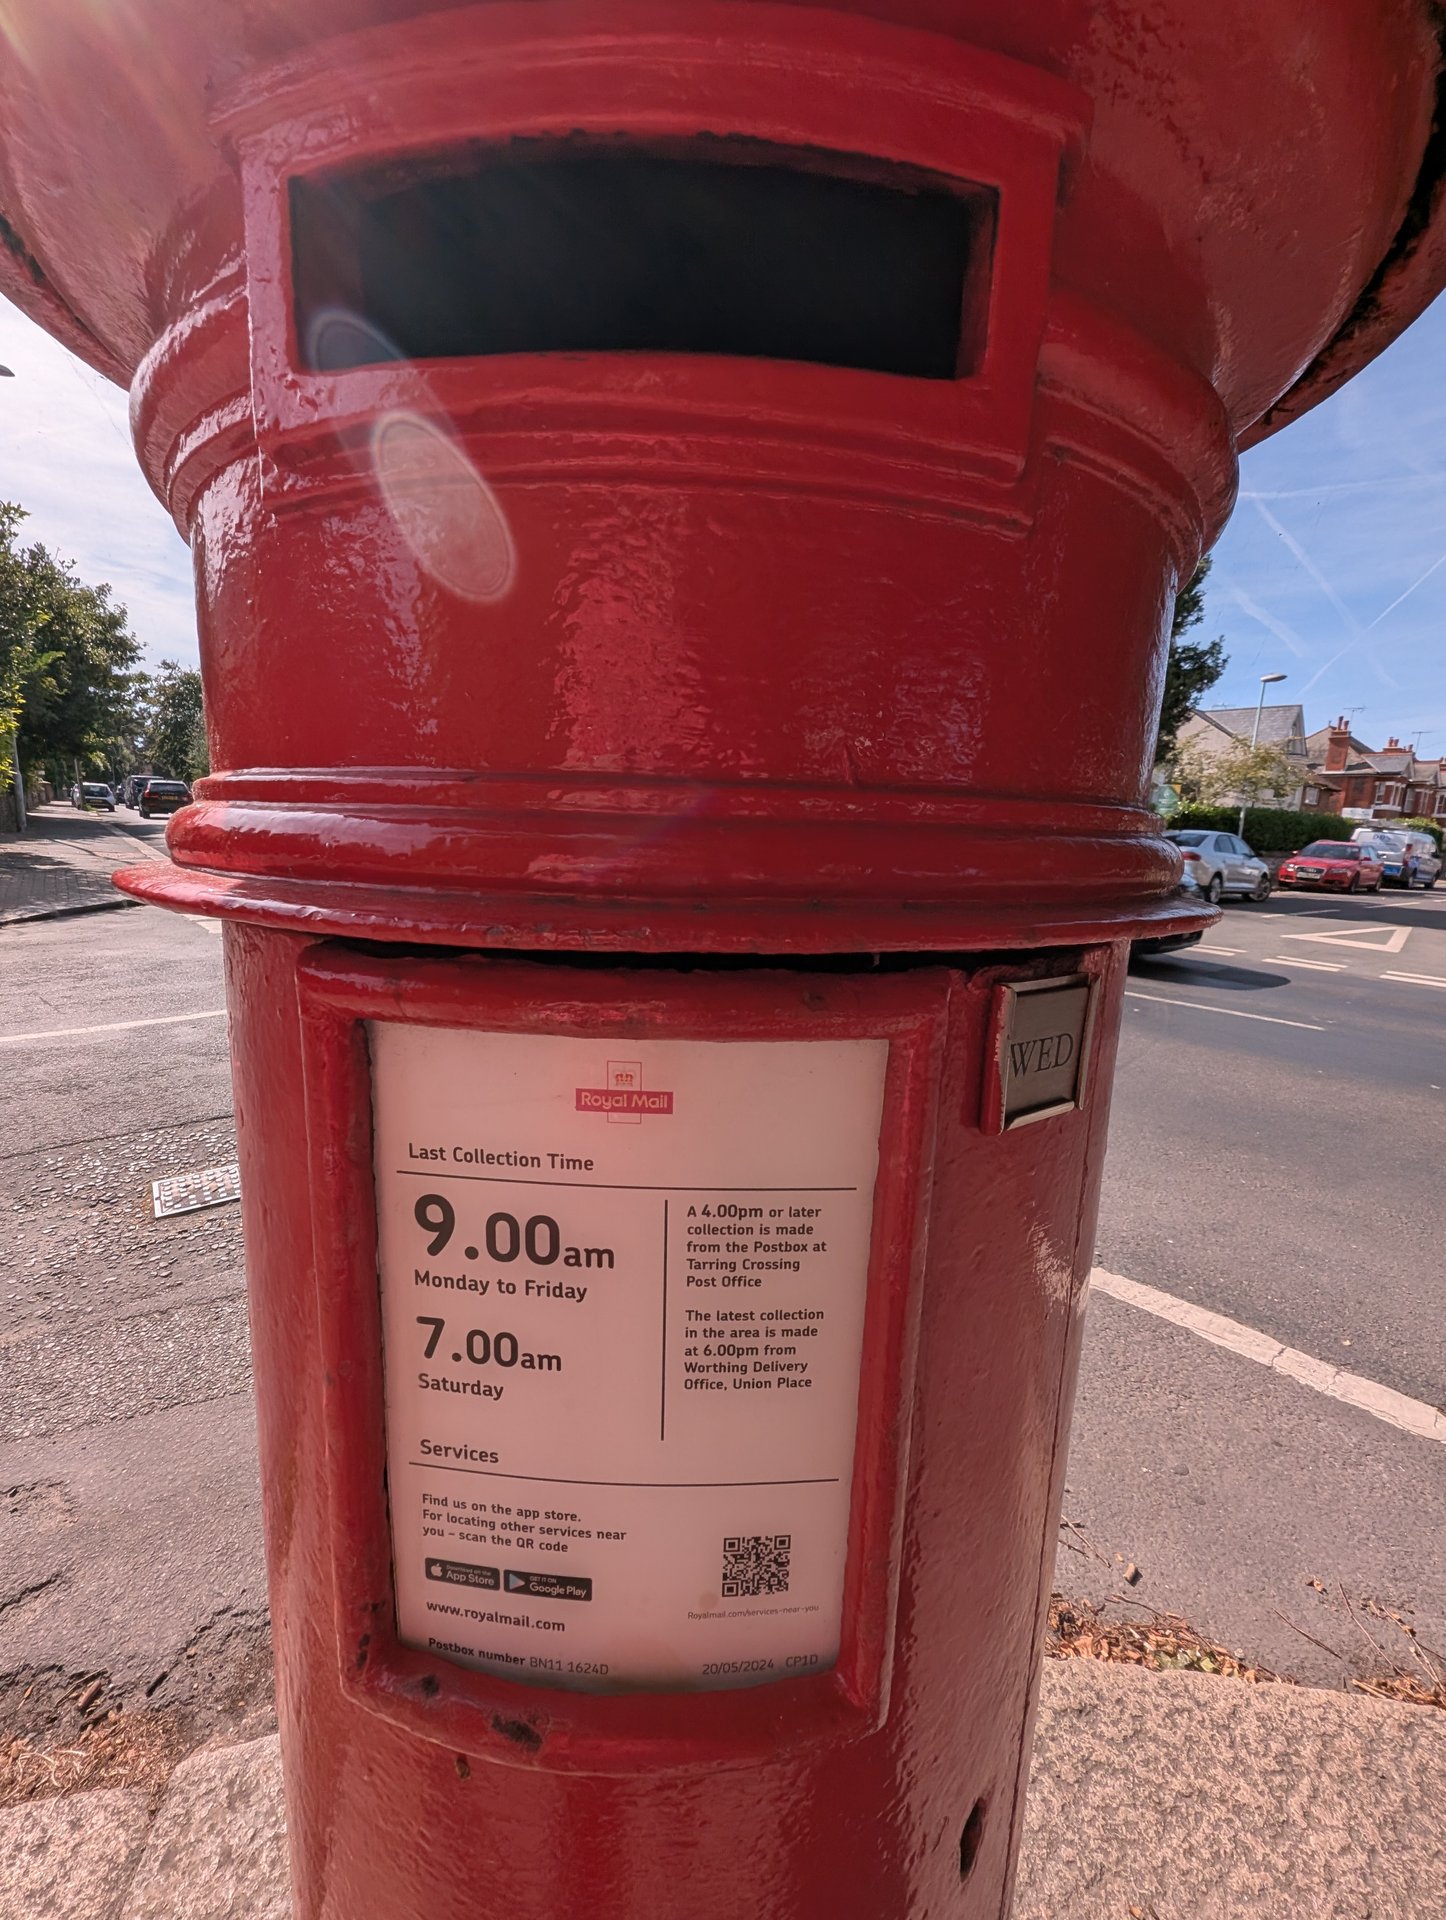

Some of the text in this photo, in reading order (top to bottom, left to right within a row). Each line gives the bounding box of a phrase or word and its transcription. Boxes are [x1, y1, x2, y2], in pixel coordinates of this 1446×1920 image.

[1009, 1033, 1074, 1078] WED
[580, 1092, 668, 1112] Royal Mail
[409, 1143, 594, 1171] Last Collection Time
[687, 1204, 821, 1220] A 4.00pm or later
[414, 1194, 614, 1269] 9.00am
[687, 1224, 813, 1235] collection is made
[687, 1241, 827, 1252] from the Postbox at
[686, 1258, 800, 1272] Tarring Crossing
[415, 1269, 587, 1303] Monday to Friday
[687, 1275, 762, 1287] Post Office
[685, 1309, 824, 1321] The latest collection
[685, 1326, 818, 1338] in the area is made
[416, 1316, 561, 1371] 7.00am
[685, 1344, 796, 1358] at 6.00pm from
[684, 1361, 808, 1375] Worthing Delivery
[418, 1373, 503, 1401] Saturday
[684, 1377, 812, 1391] Office, Union Place
[421, 1439, 499, 1463] Services
[423, 1494, 581, 1522] Find us on the app store.
[423, 1509, 627, 1540] For locating other services near
[423, 1527, 444, 1536] you
[459, 1532, 486, 1543] scan
[491, 1535, 511, 1546] the
[517, 1537, 534, 1549] QR
[539, 1541, 568, 1552] code
[446, 1571, 495, 1586] App Store
[529, 1583, 587, 1598] Google Play
[427, 1602, 565, 1631] www.royalmail.com
[428, 1637, 609, 1675] Postbox number BN11 1624D
[702, 1654, 819, 1675] 20/05/2024 CP1D
